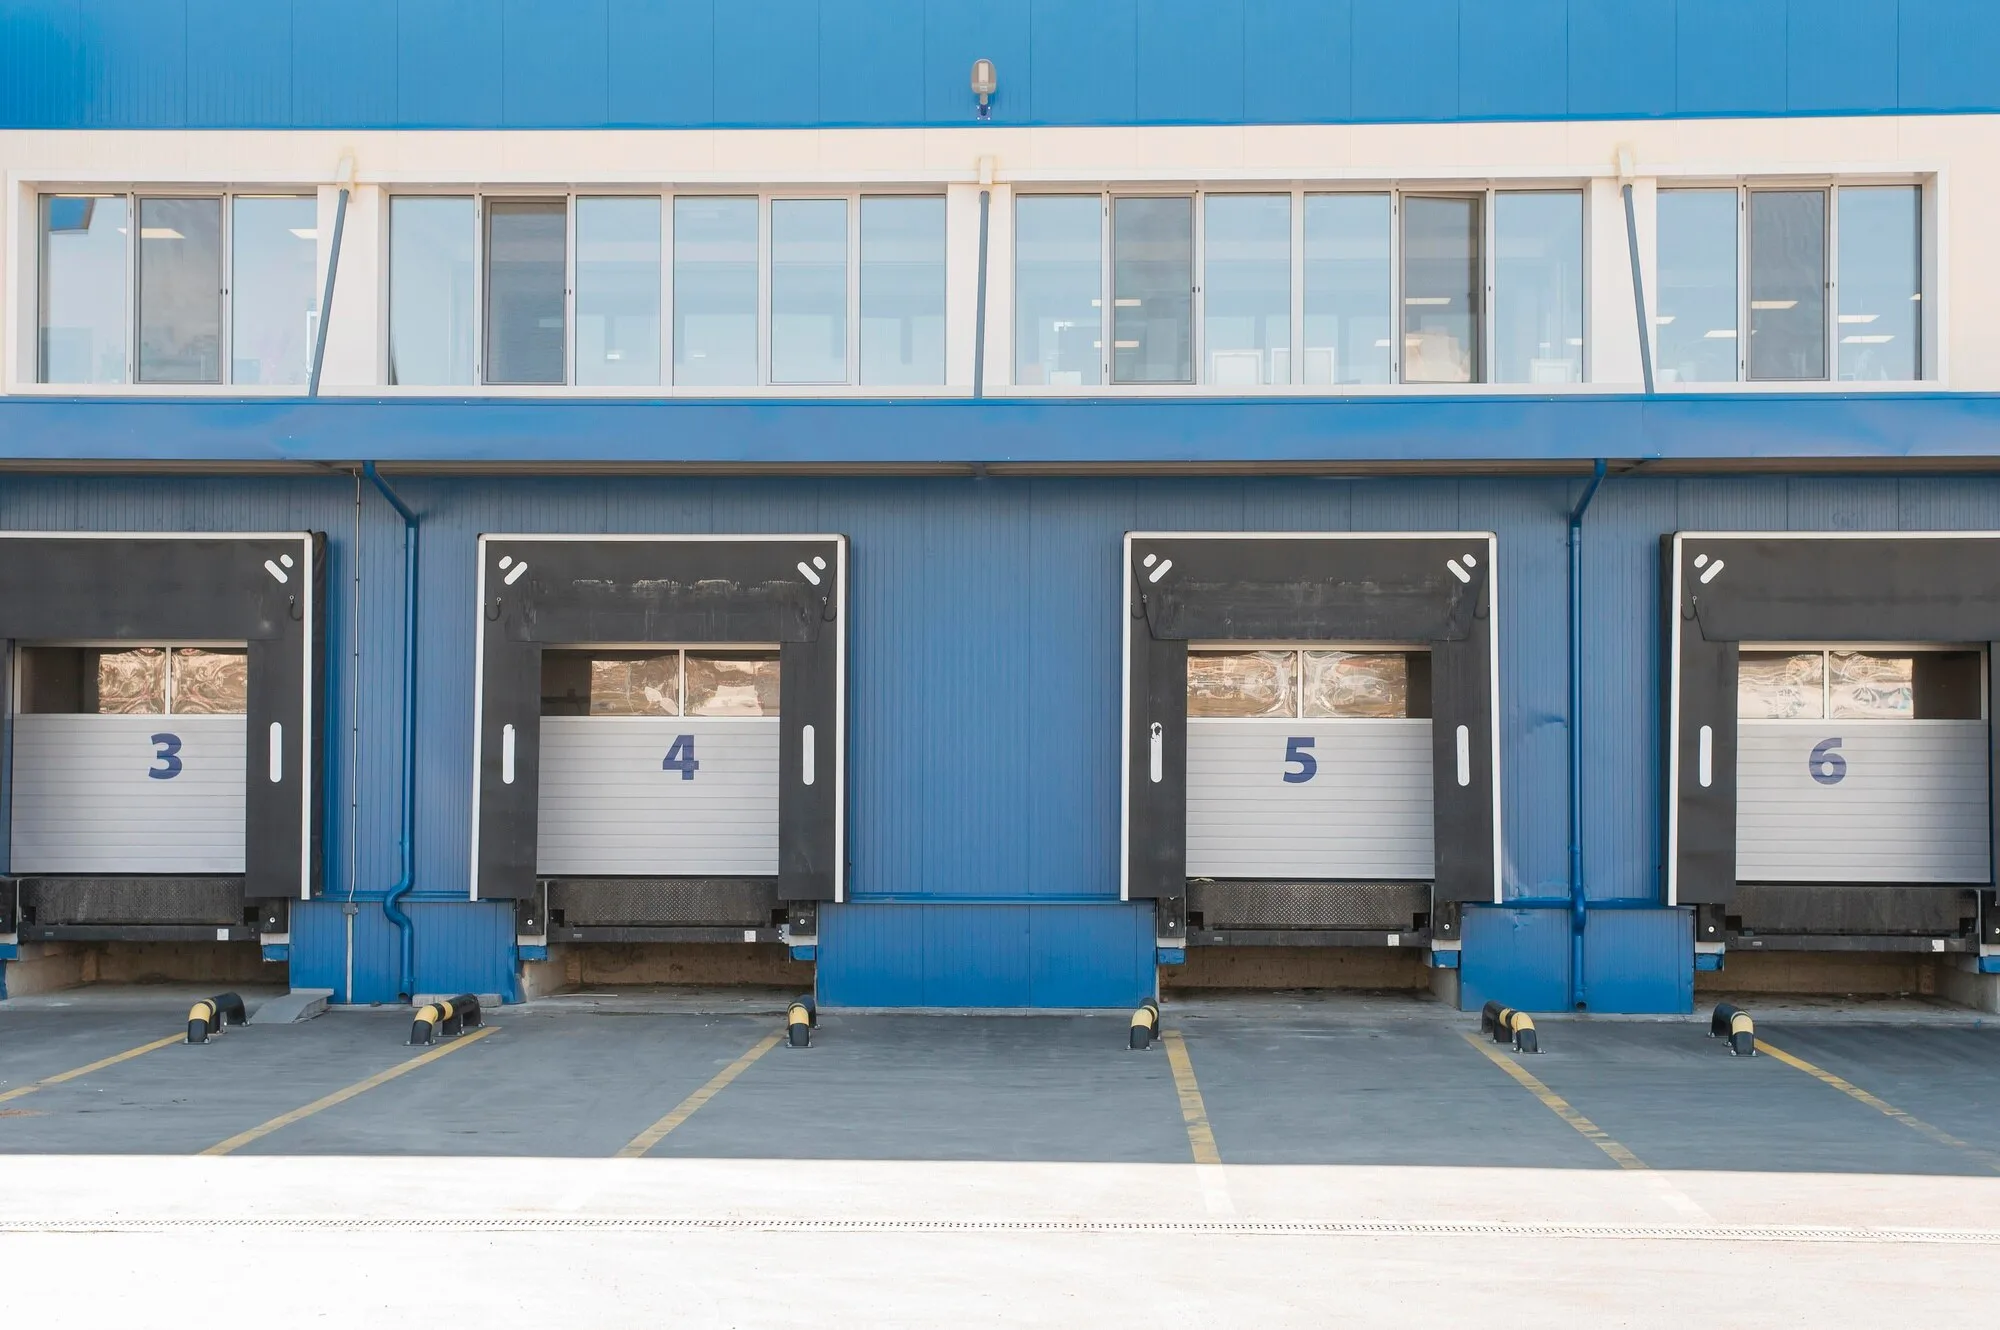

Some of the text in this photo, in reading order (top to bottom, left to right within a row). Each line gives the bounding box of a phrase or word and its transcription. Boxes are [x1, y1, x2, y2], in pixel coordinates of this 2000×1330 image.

[149, 733, 182, 779] 3
[663, 735, 699, 780] 4
[1283, 737, 1317, 783] 5
[1809, 738, 1847, 785] 6
